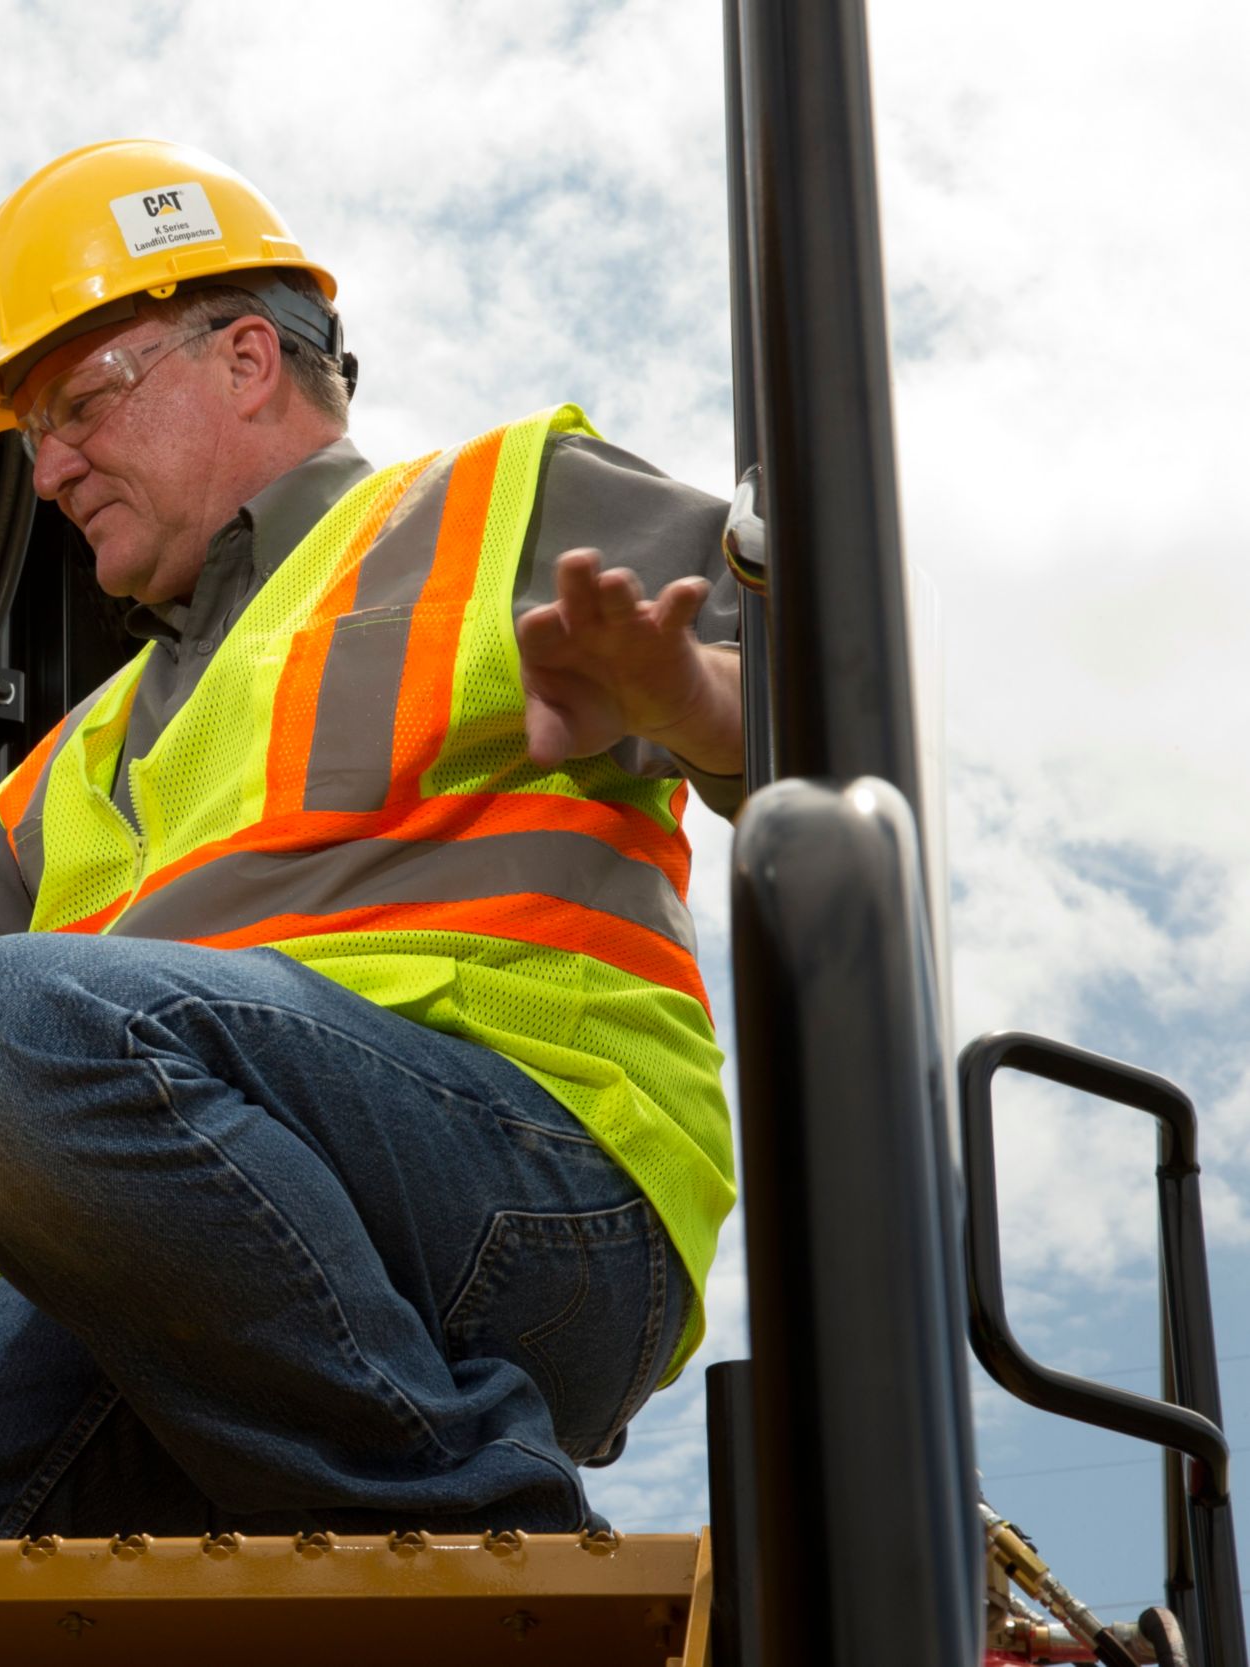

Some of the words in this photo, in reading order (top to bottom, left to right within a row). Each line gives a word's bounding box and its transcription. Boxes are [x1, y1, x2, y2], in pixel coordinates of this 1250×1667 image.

[142, 190, 182, 217] CAT
[134, 236, 167, 252] Landfill
[168, 228, 215, 243] Compactors
[154, 226, 162, 235] K
[162, 221, 190, 234] Series
